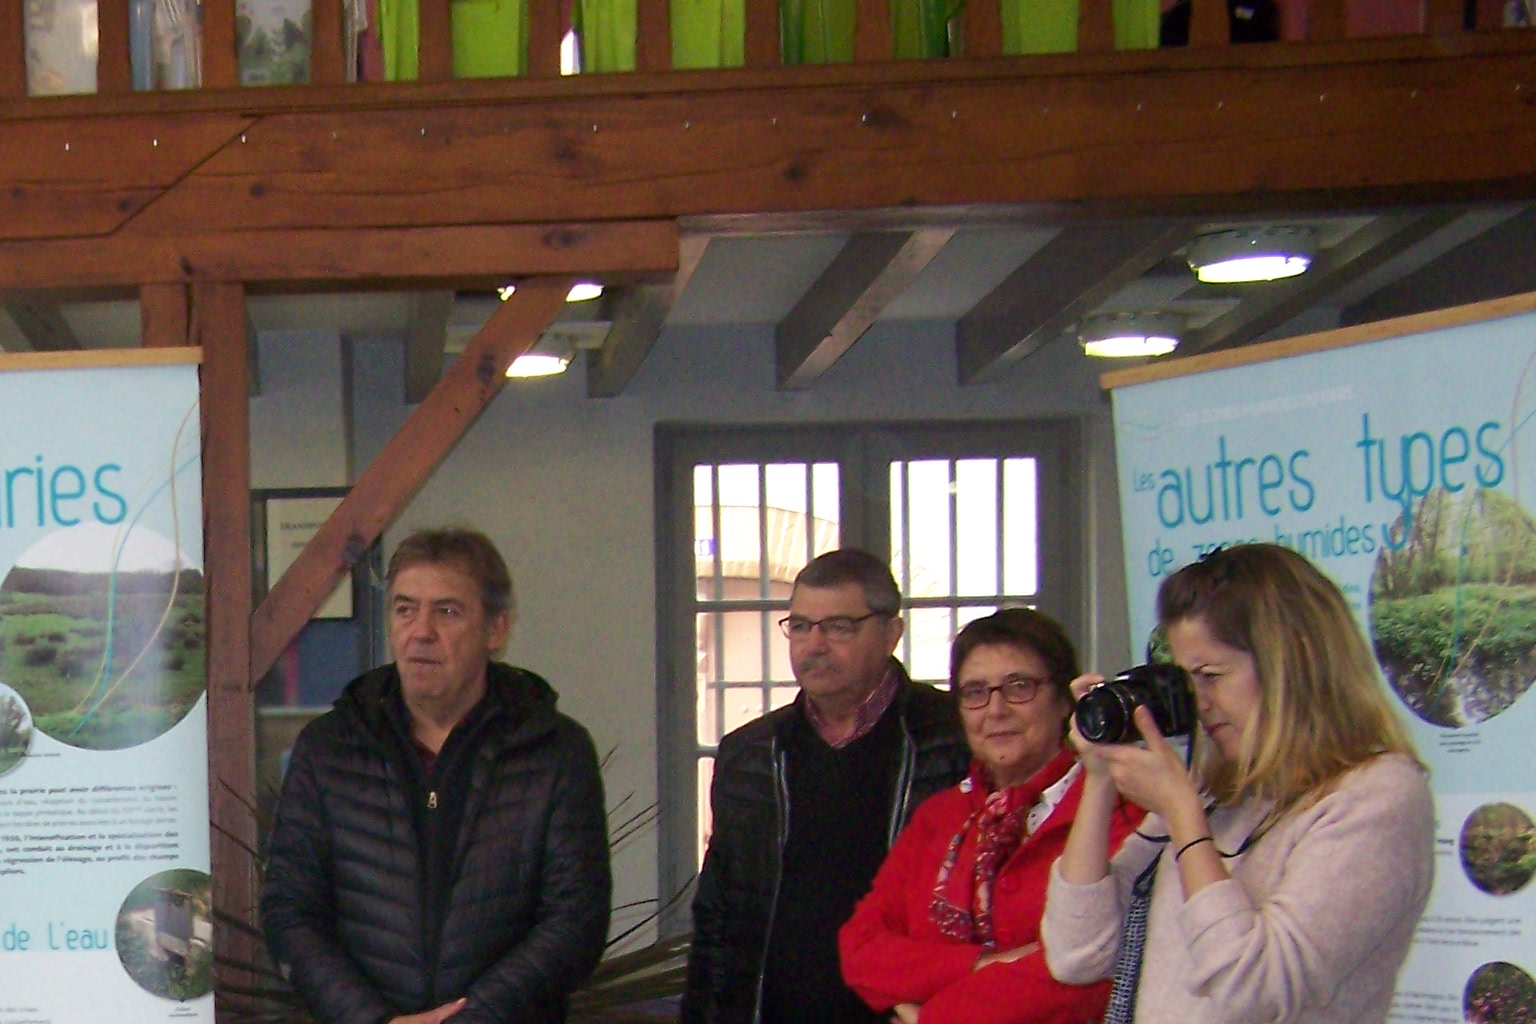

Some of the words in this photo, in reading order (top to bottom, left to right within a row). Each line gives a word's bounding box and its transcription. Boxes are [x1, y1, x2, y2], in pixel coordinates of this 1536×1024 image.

[1132, 468, 1156, 493] Les
[1157, 433, 1315, 529] autres
[1356, 412, 1506, 551] types
[1148, 537, 1174, 577] de
[2, 924, 31, 952] de
[48, 919, 109, 952] l'eau
